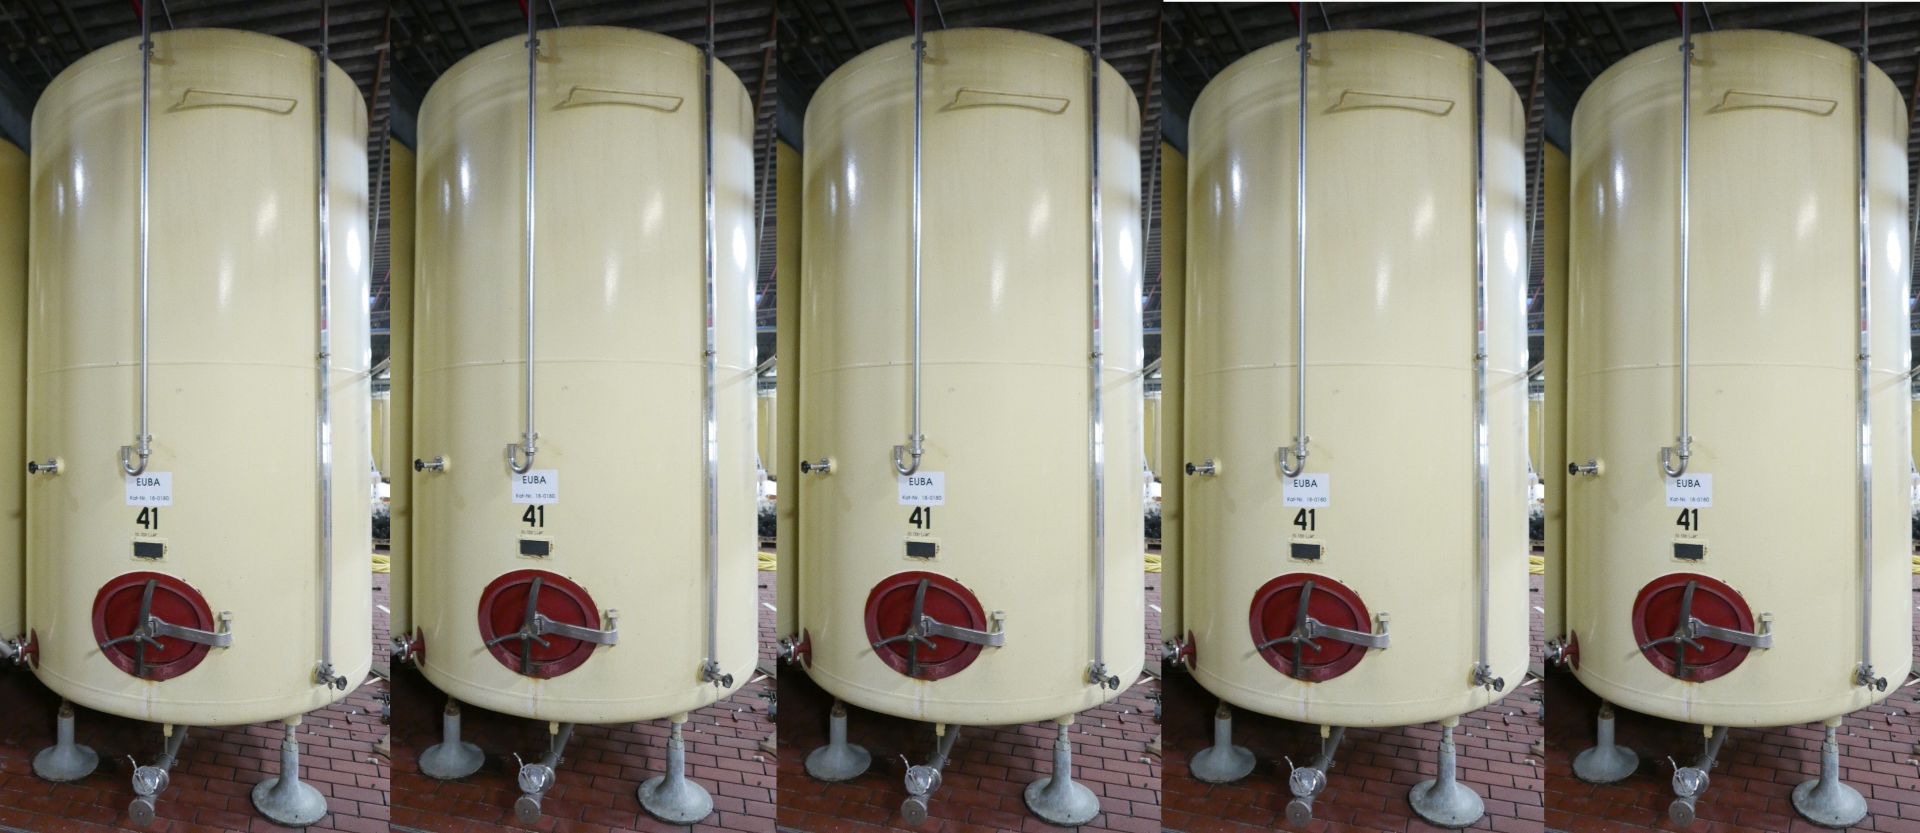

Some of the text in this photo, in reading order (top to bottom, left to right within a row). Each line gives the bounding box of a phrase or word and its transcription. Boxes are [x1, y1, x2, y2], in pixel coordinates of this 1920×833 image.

[136, 478, 160, 487] EUBA
[522, 475, 547, 485] EUBA
[909, 477, 933, 486] EUBA
[1293, 479, 1318, 488] EUBA
[1676, 479, 1701, 488] EUBA
[136, 506, 158, 530] 41
[522, 504, 544, 528] 41
[909, 506, 931, 530] 41
[1293, 507, 1316, 531] 41
[1676, 507, 1699, 531] 41
